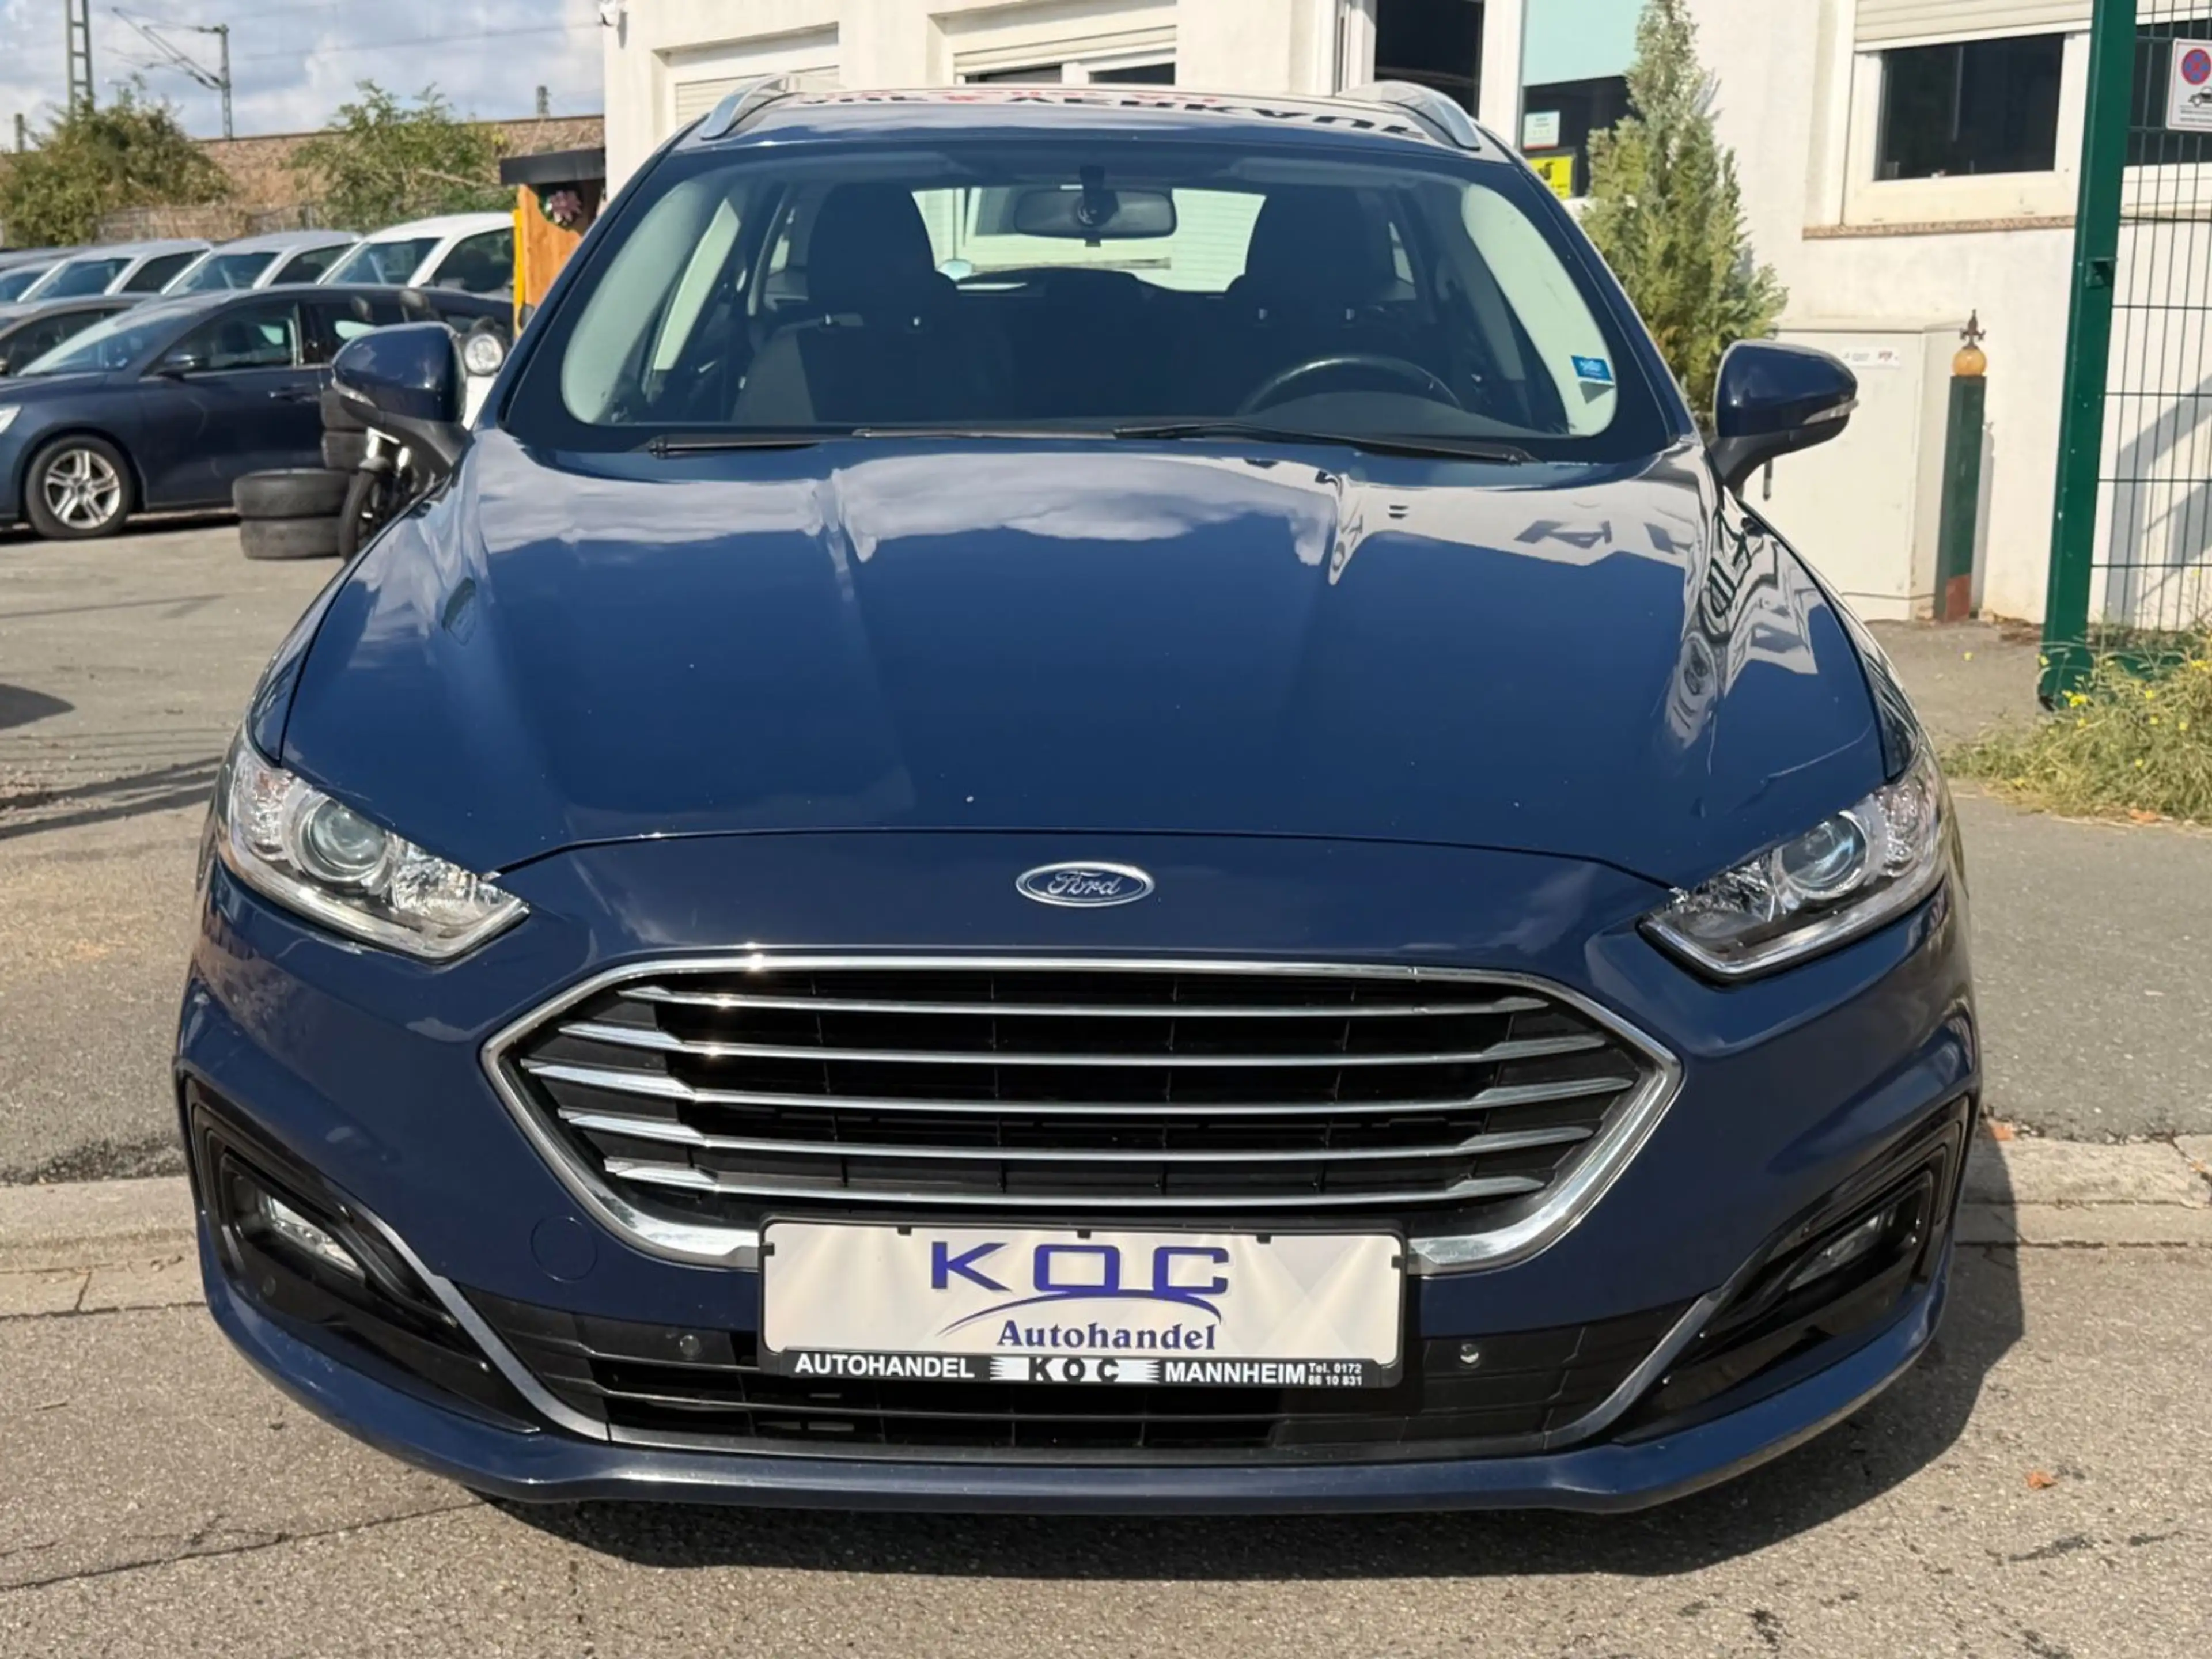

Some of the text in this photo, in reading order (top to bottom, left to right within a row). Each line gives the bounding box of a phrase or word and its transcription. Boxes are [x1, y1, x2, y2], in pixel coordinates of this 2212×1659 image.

[1047, 870, 1123, 895] Ford
[931, 1241, 1229, 1297] KOC
[997, 1320, 1217, 1350] Autohandel
[794, 1353, 975, 1378] AUTOHANDEL
[1165, 1362, 1305, 1385] MANNHEIM
[1309, 1362, 1330, 1374] Tel.
[1333, 1363, 1362, 1374] 0172
[1326, 1374, 1339, 1386] 10
